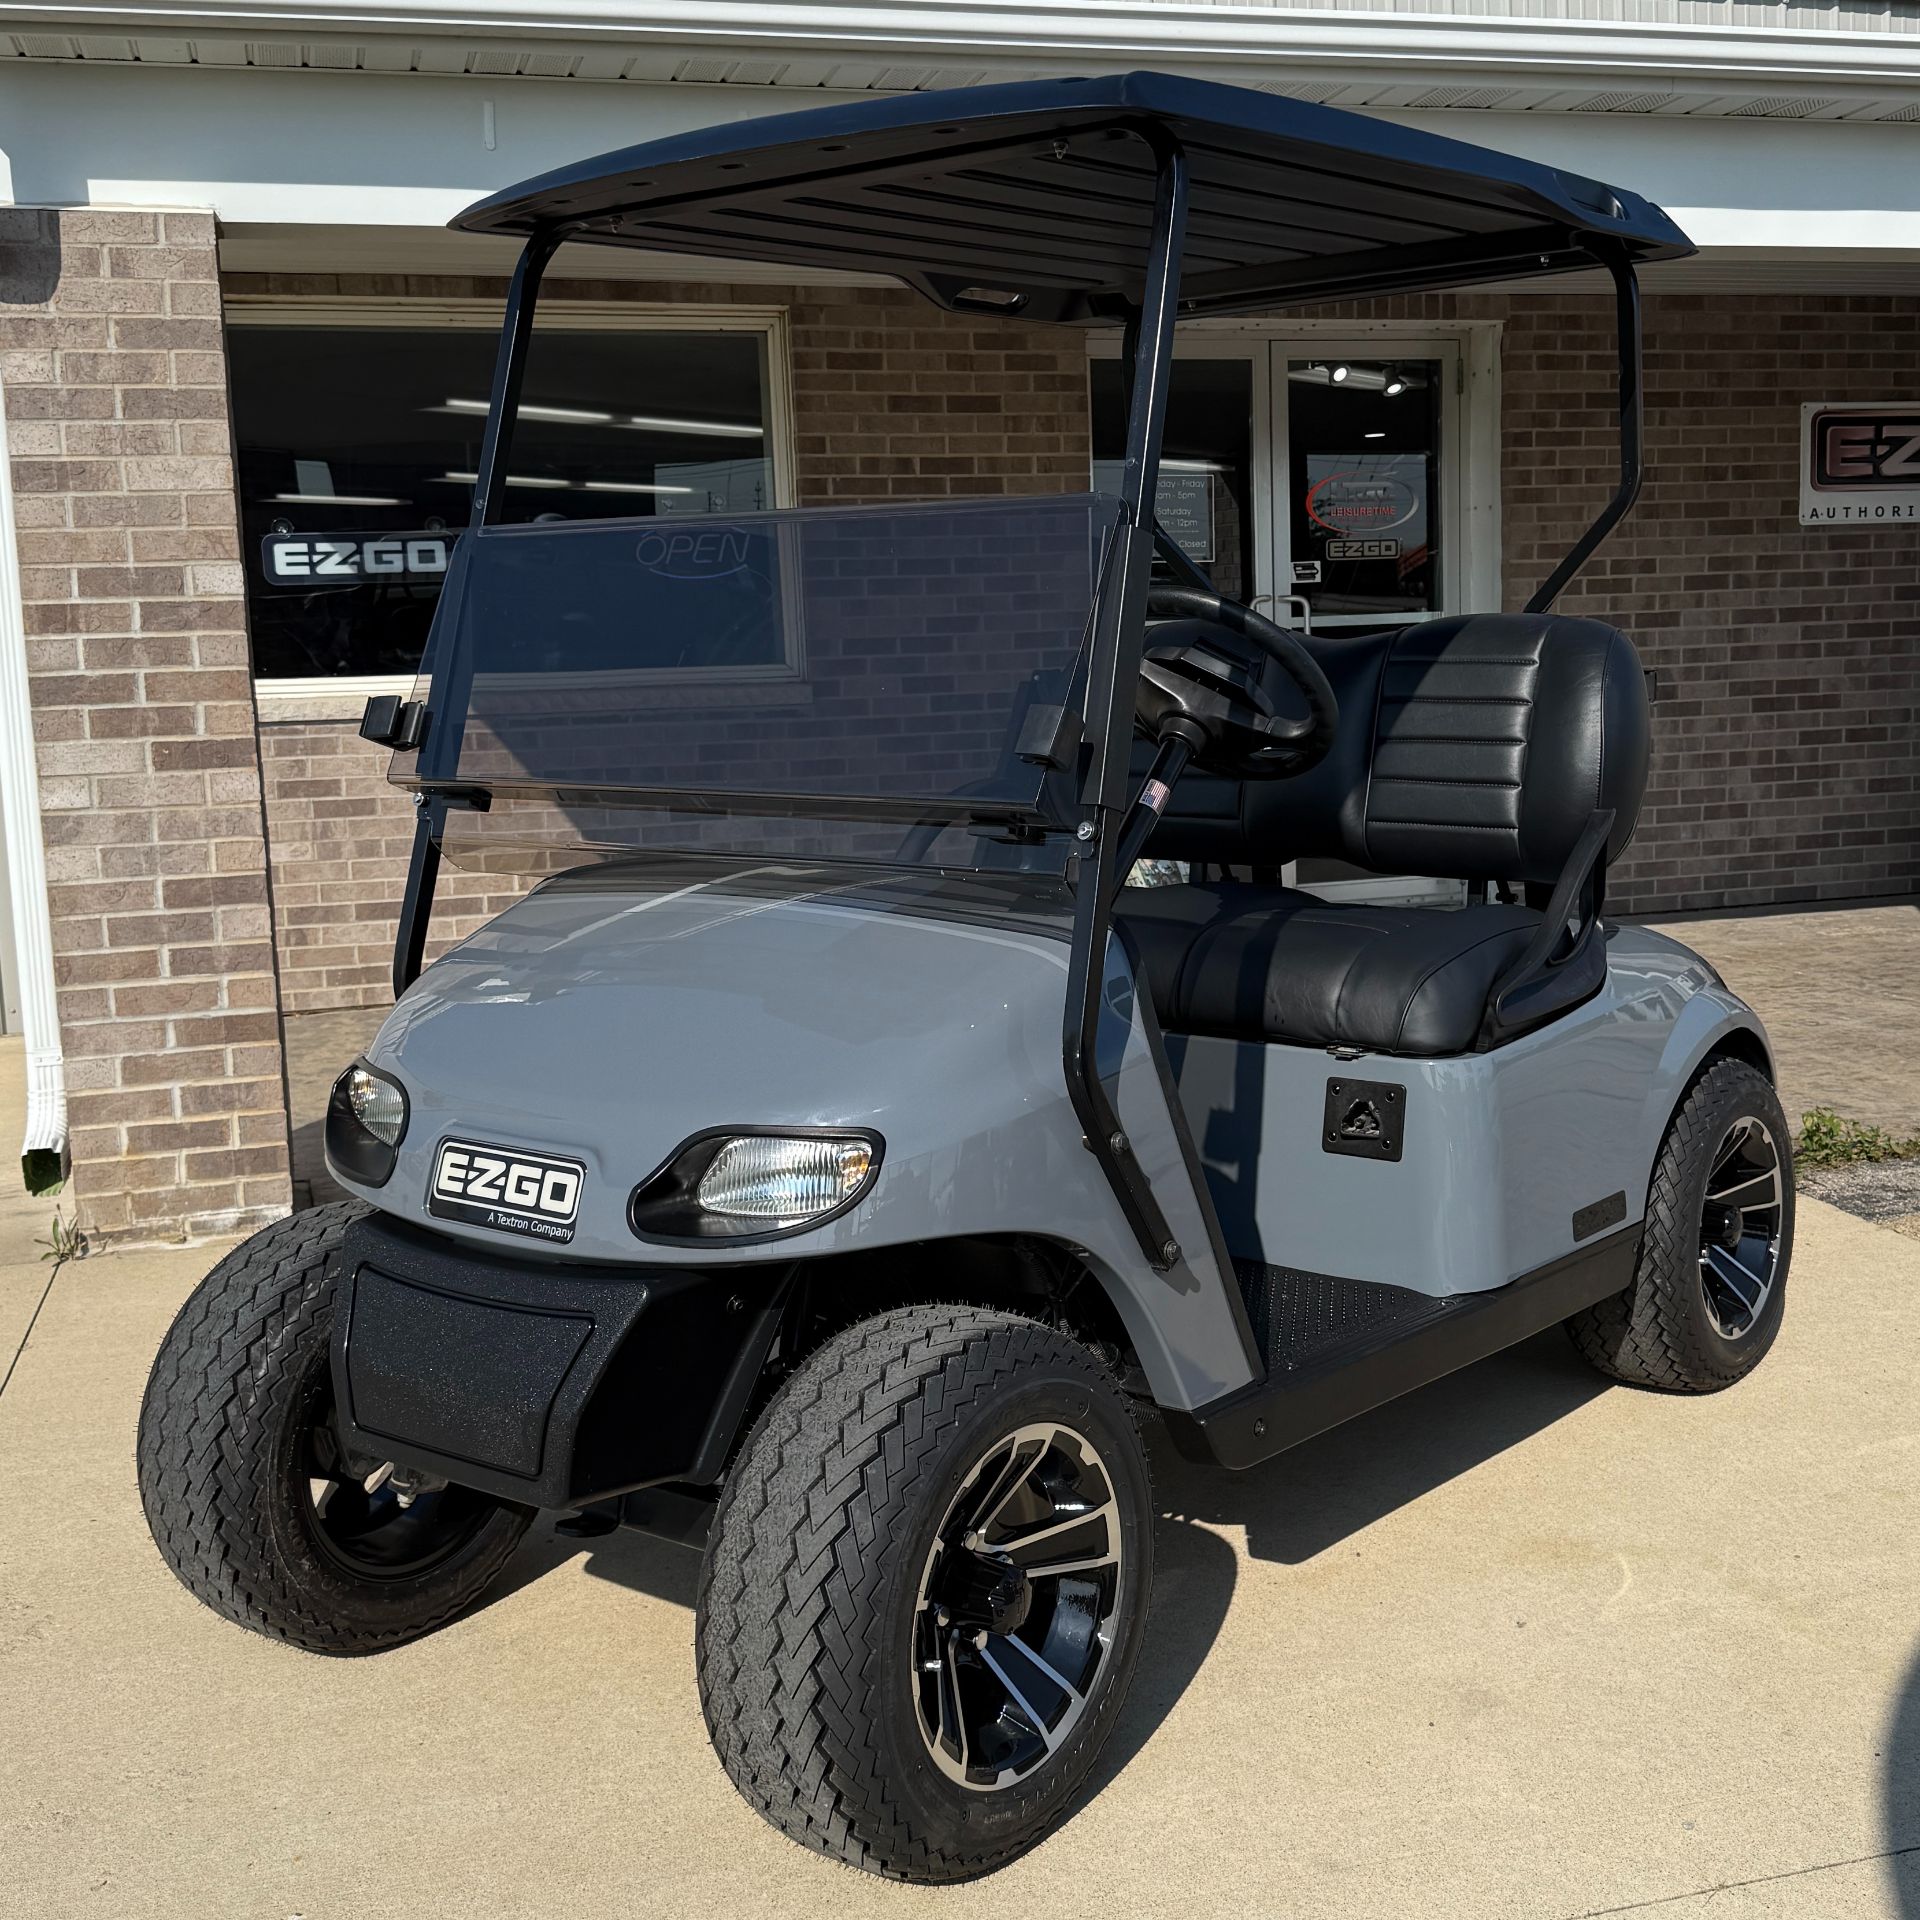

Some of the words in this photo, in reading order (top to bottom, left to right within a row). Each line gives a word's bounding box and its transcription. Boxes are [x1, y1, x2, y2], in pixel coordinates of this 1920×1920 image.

[1182, 480, 1205, 488] Friday
[1178, 491, 1196, 499] 5pm
[1157, 507, 1191, 516] Saturday
[1330, 506, 1397, 517] LEISURETIME
[1810, 505, 1914, 519] AUTHORI
[1177, 519, 1198, 527] 12pm
[636, 533, 750, 565] OPEN
[1179, 540, 1207, 548] Closed
[1330, 541, 1397, 557] EZGO
[273, 541, 448, 576] EZGO
[438, 1151, 578, 1215] EZGO
[488, 1212, 495, 1222] A
[498, 1213, 528, 1230] Textron
[531, 1221, 574, 1240] Company
